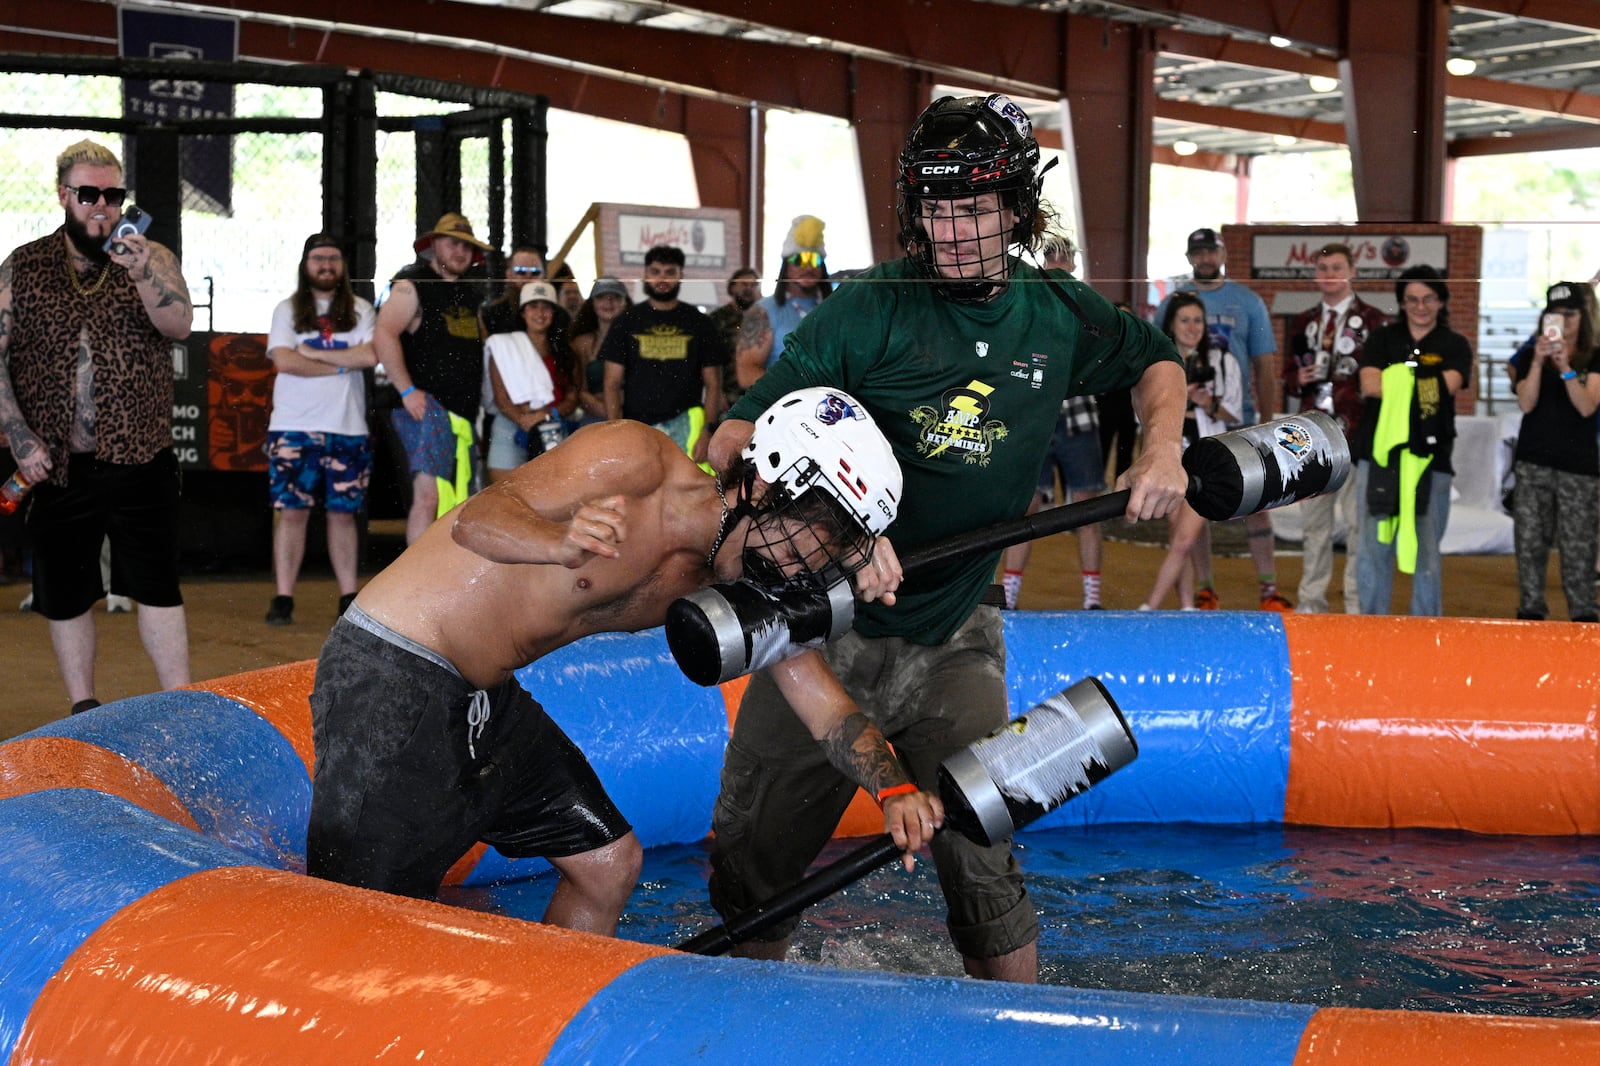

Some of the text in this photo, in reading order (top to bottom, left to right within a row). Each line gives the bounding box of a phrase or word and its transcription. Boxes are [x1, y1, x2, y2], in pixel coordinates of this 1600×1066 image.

[921, 165, 961, 175] CCM
[944, 410, 980, 428] AMP
[800, 422, 820, 440] CCM
[877, 498, 894, 520] CCM
